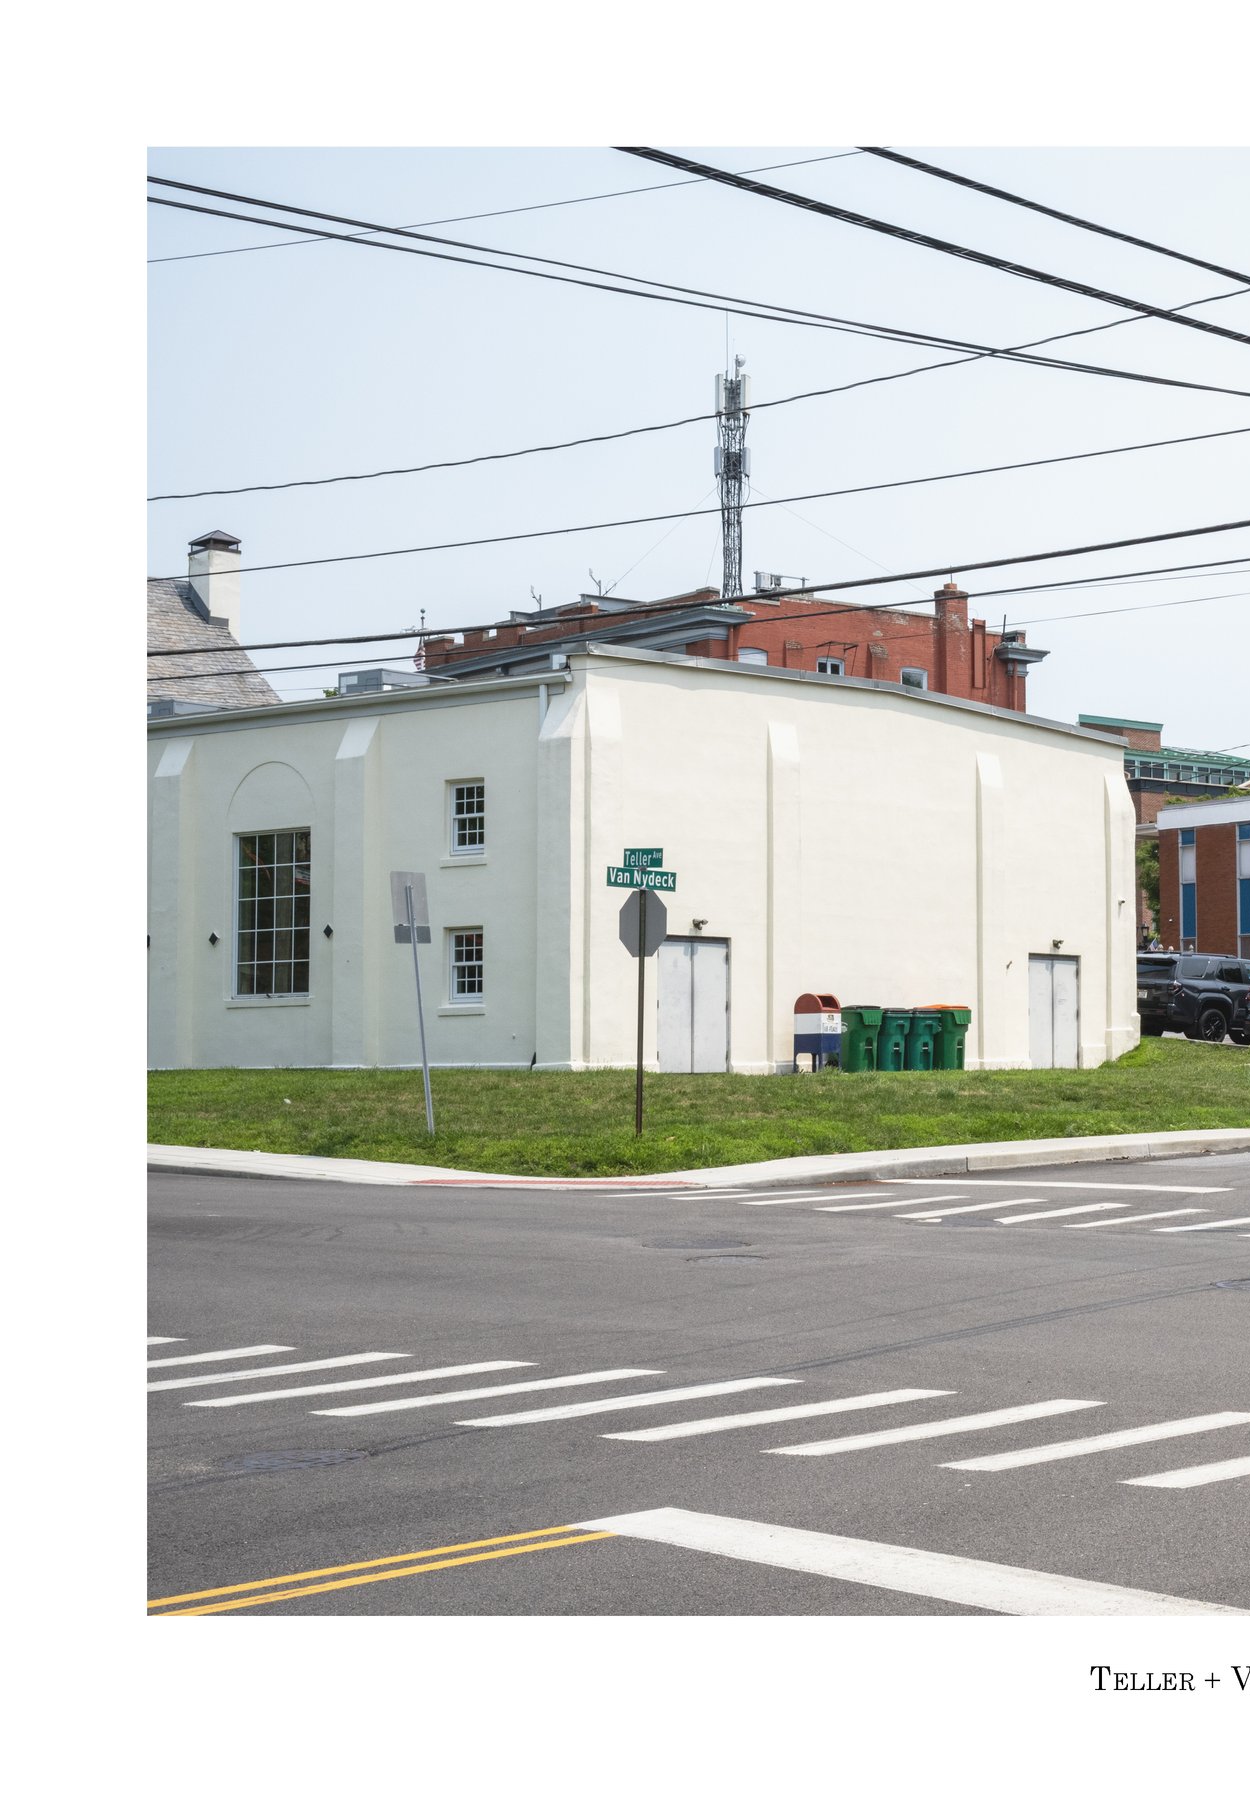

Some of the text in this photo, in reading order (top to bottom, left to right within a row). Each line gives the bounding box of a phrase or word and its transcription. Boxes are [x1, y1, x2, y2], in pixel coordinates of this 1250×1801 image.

[625, 851, 662, 866] Teller Ave
[609, 867, 674, 888] Van Nydeck
